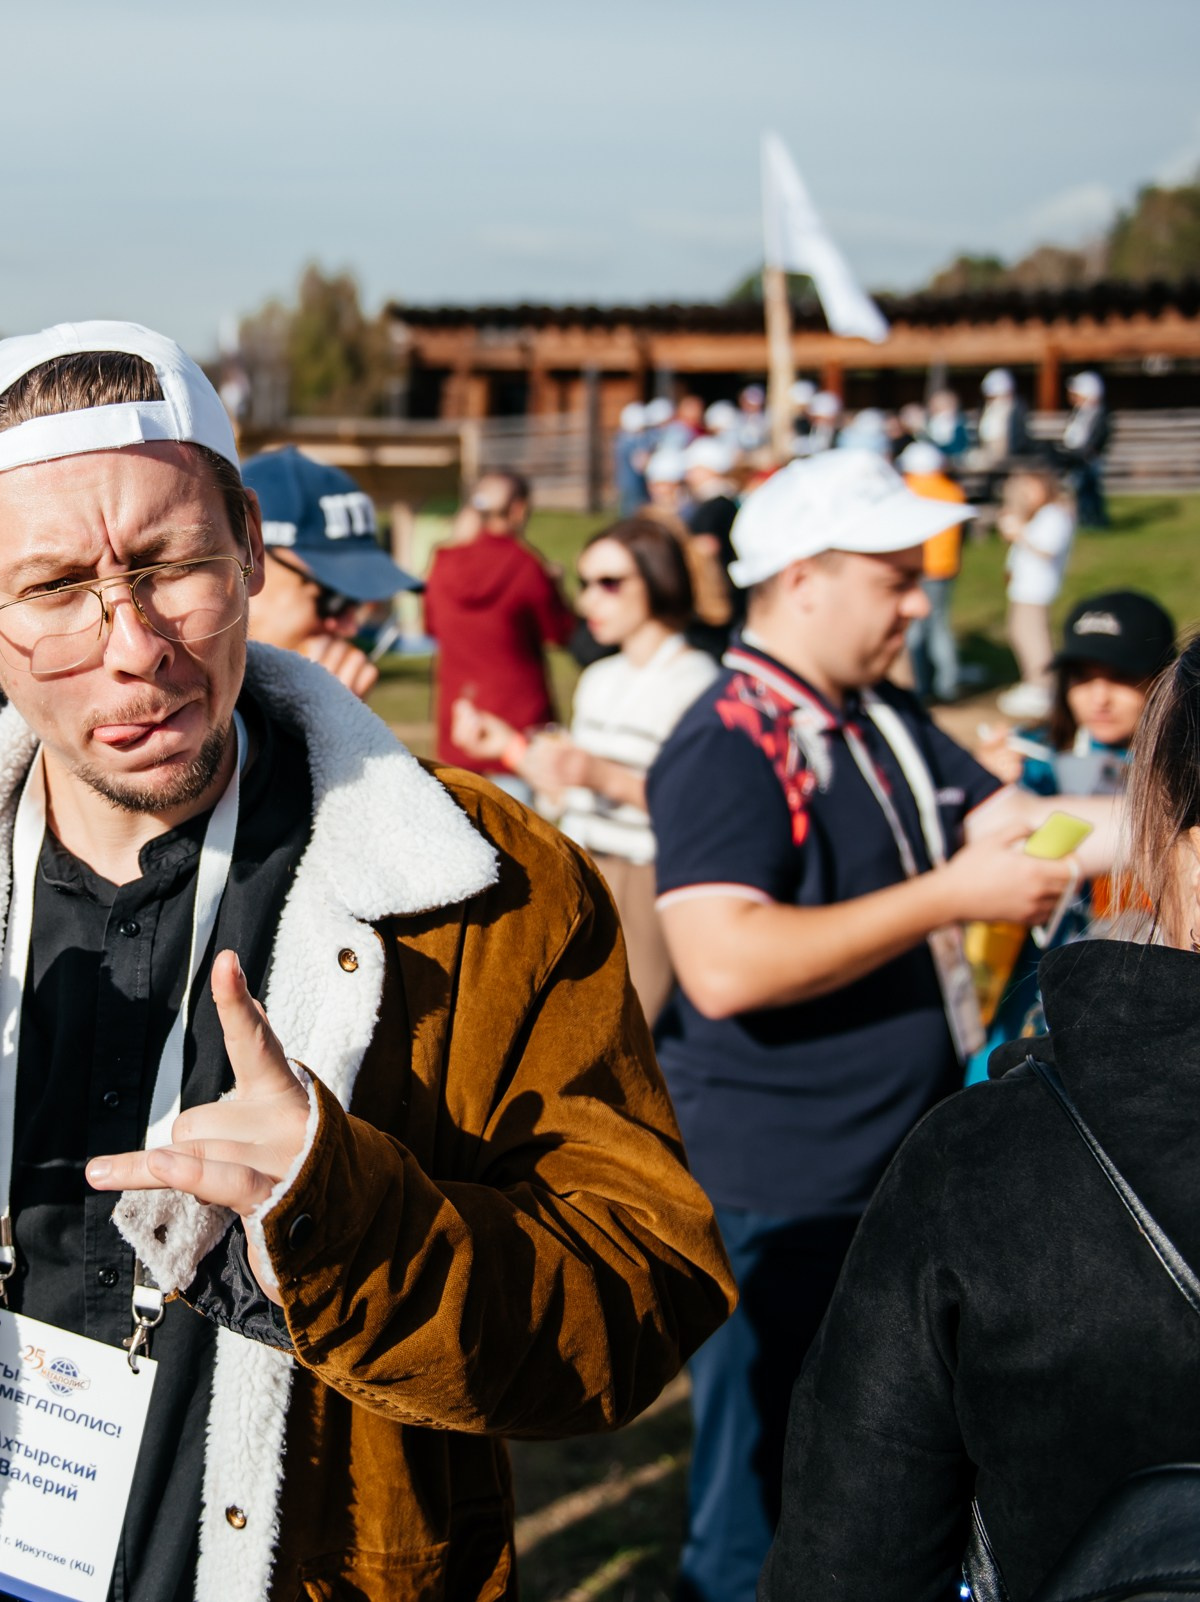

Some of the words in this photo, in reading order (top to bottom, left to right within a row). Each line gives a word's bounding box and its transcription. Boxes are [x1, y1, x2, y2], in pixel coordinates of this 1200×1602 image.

[23, 1344, 46, 1370] 25
[15, 1538, 67, 1566] Иркутске
[69, 1558, 96, 1577] (КЦ)
